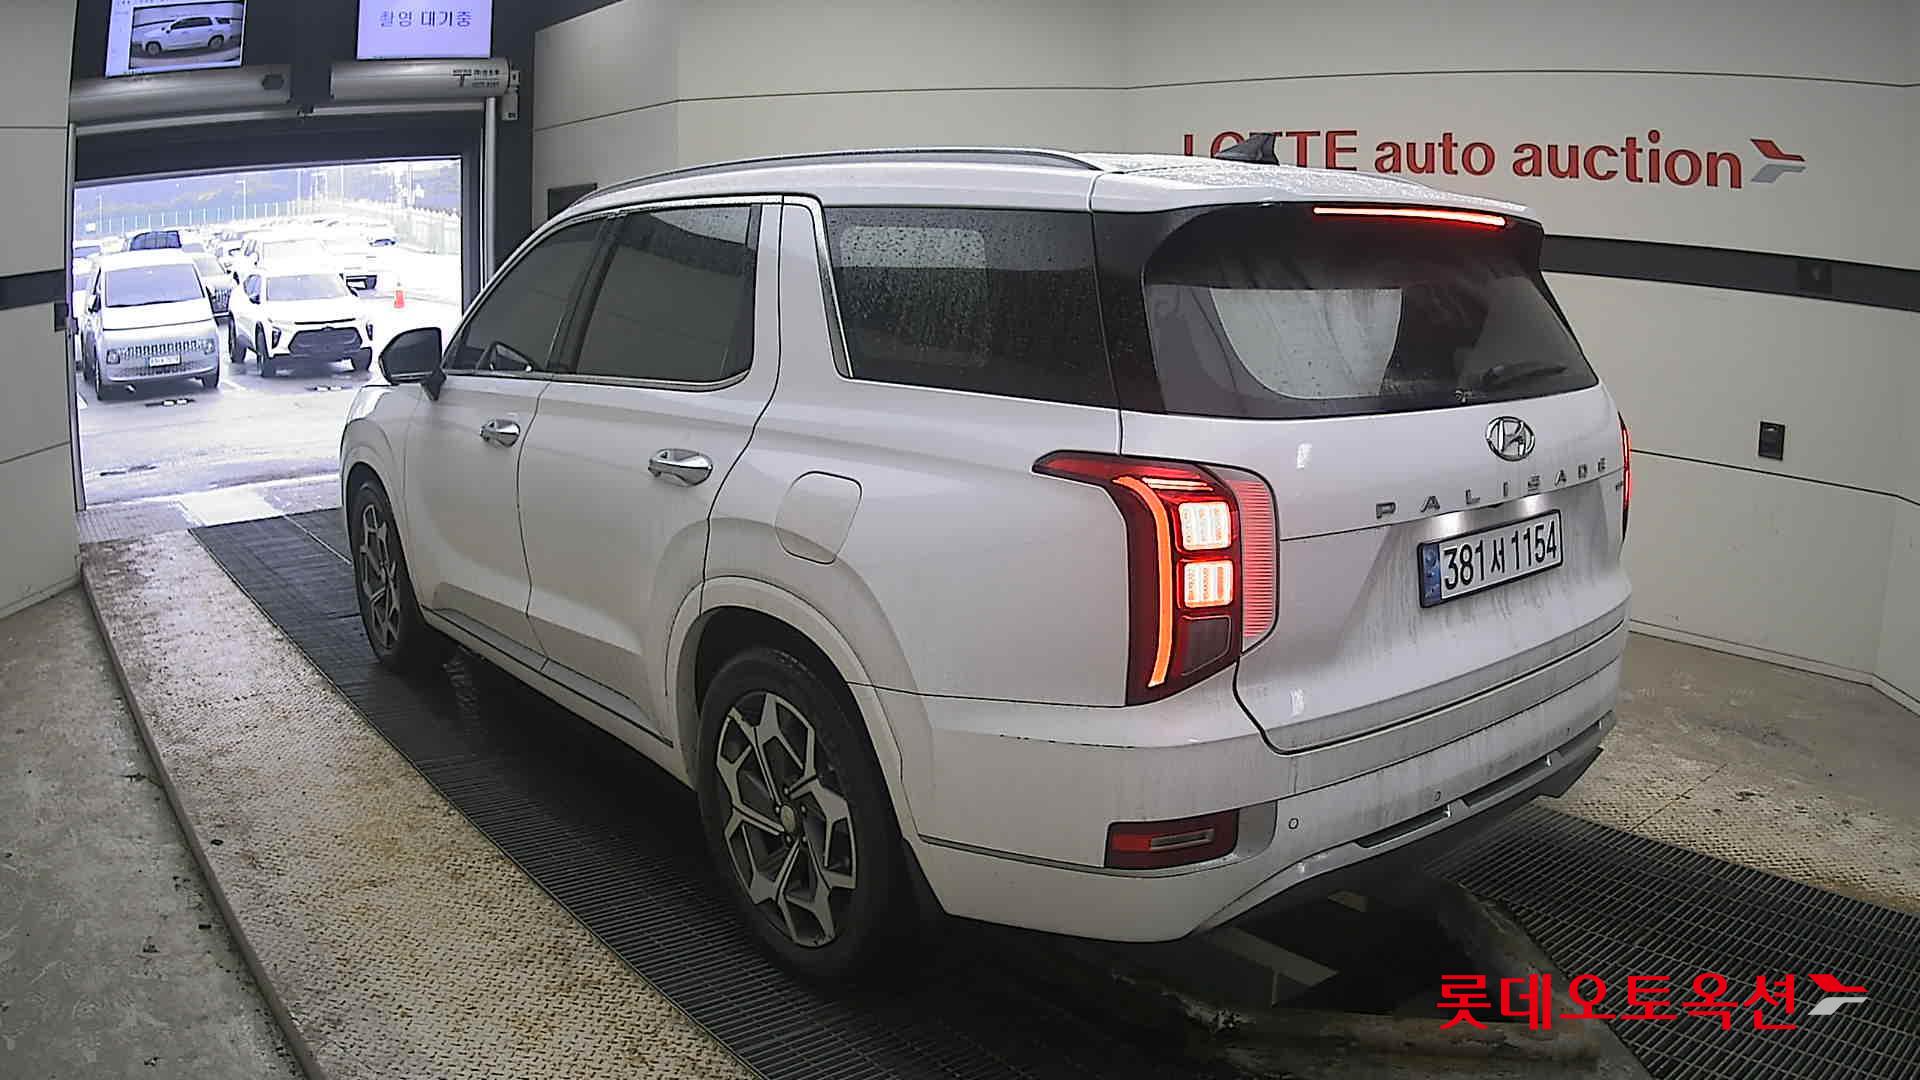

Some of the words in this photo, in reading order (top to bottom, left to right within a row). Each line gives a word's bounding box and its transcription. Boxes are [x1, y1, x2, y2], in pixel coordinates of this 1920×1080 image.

[421, 11, 472, 27] 대기중
[1184, 131, 1358, 170] OTE
[1375, 131, 1496, 175] auto
[1512, 130, 1743, 188] auction
[1375, 457, 1607, 519] PALISADE
